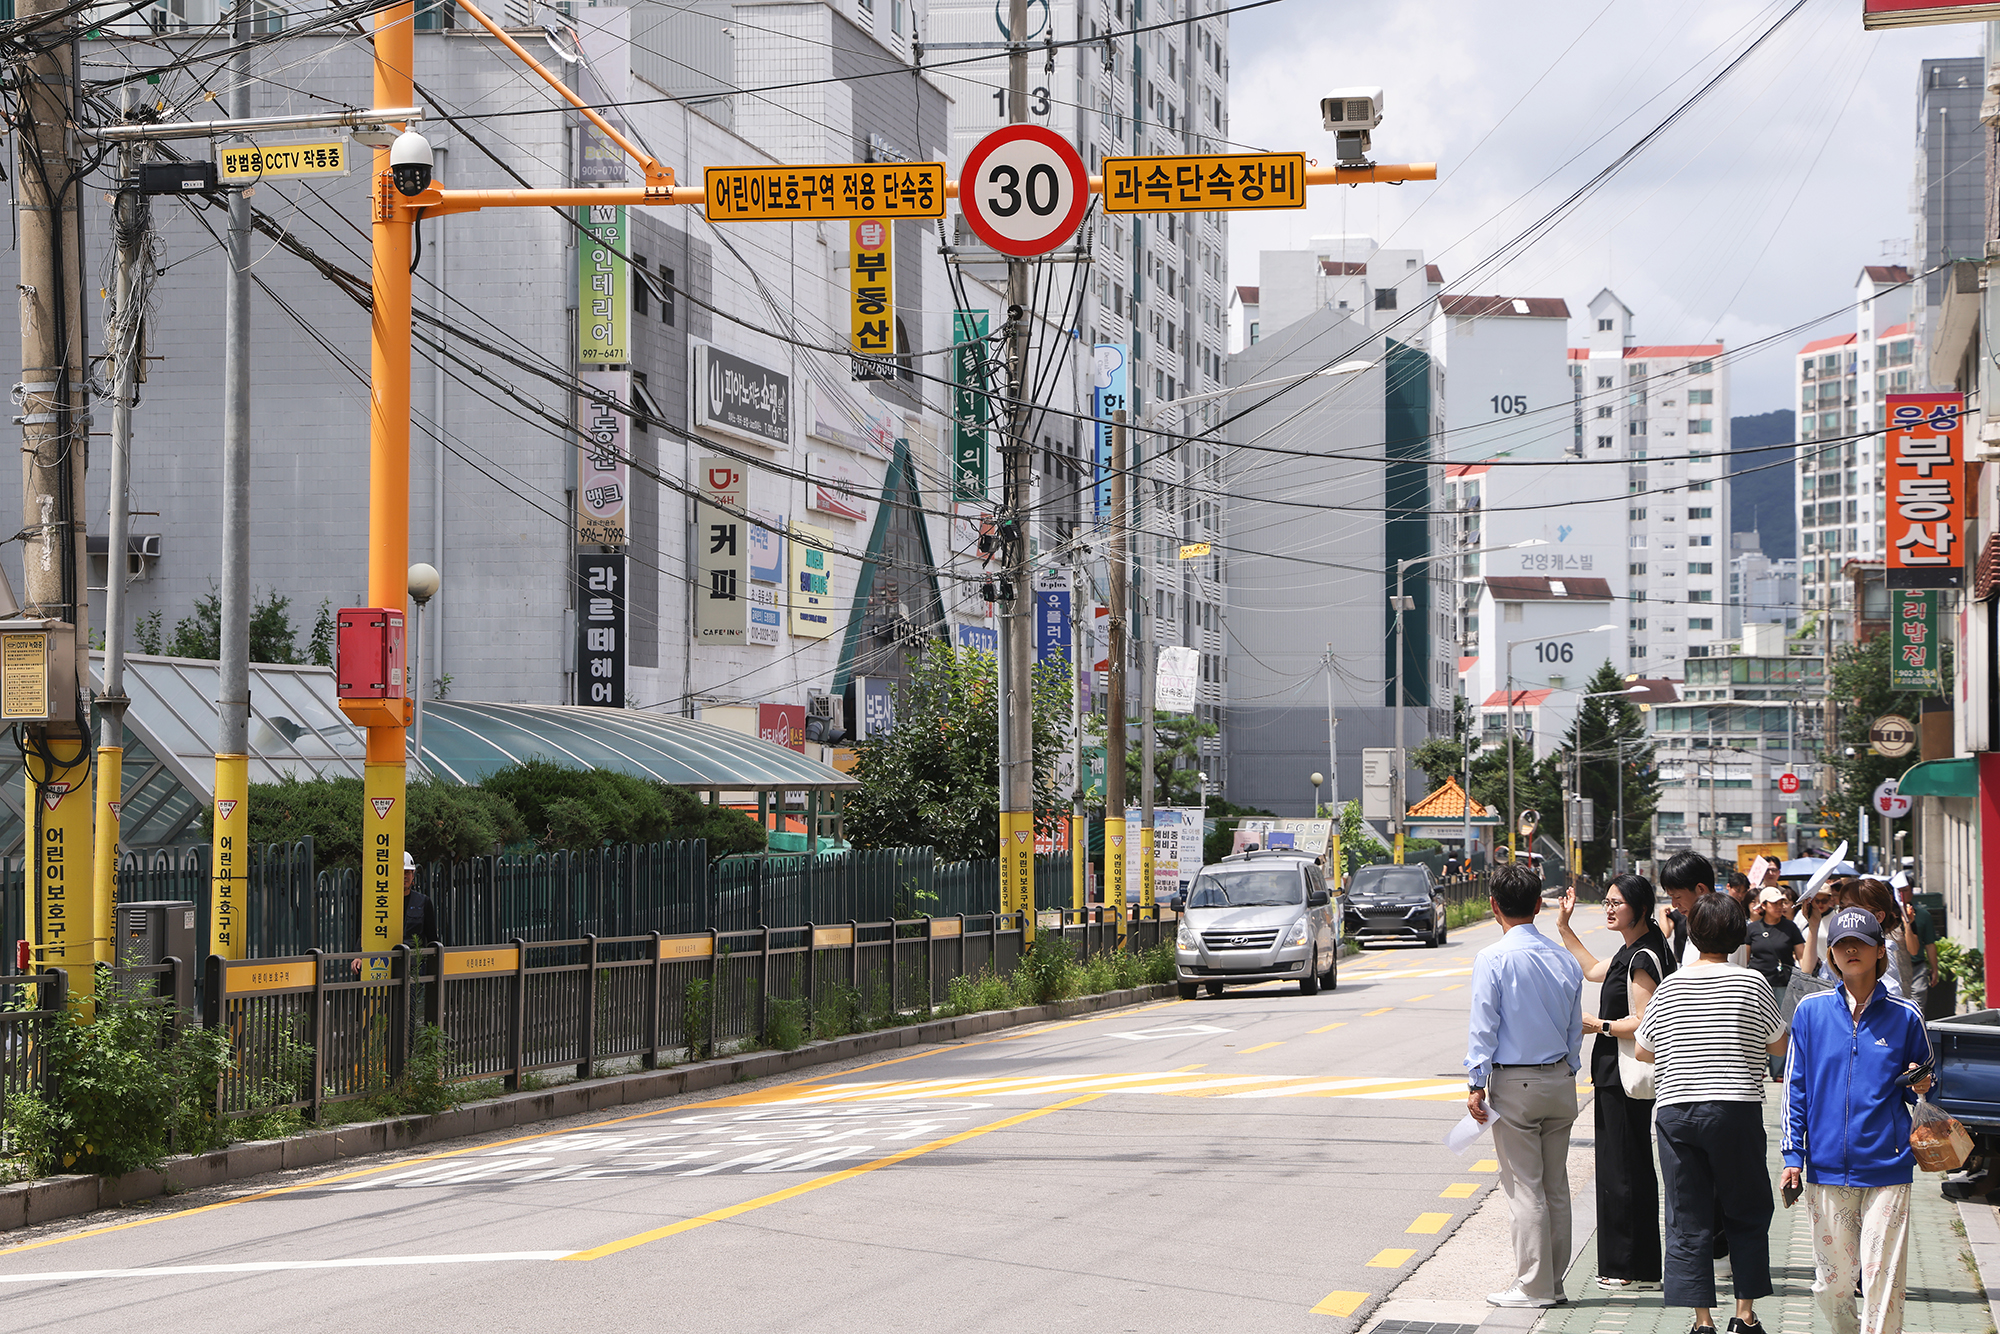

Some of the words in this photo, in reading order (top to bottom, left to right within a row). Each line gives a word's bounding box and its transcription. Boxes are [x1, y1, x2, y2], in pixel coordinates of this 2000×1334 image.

[226, 153, 262, 174] 방범용
[265, 152, 300, 170] CCTV
[303, 148, 340, 169] 작동중
[582, 166, 624, 176] 906-0707
[584, 146, 623, 163] Body
[716, 174, 834, 213] 어린이보호구역
[843, 172, 876, 211] 적용
[884, 171, 935, 210] 단속중
[988, 163, 1060, 217] 30
[1114, 161, 1296, 204] 과속단속장비
[860, 223, 882, 246] 탑
[591, 248, 614, 346] 인테리어
[856, 252, 890, 349] 부동산
[582, 349, 625, 359] 997-6471
[1490, 395, 1528, 414] 105
[1892, 405, 1959, 432] 우성
[587, 389, 620, 471] 부동산
[585, 483, 623, 510] 뱅크
[1895, 434, 1955, 566] 부동산
[710, 523, 736, 601] 커피
[1520, 554, 1593, 571] 건영캐스빌
[587, 565, 618, 703] 라르떼헤어
[1535, 642, 1574, 663] 106
[1880, 730, 1906, 742] TLJ
[46, 828, 66, 957] 어린이보호구역
[219, 836, 232, 946] 어린이보호구역
[374, 833, 390, 939] 어린이보호구역
[1019, 851, 1029, 911] 어린이보호구역
[1842, 917, 1860, 929] CITY
[1850, 912, 1867, 925] YORK
